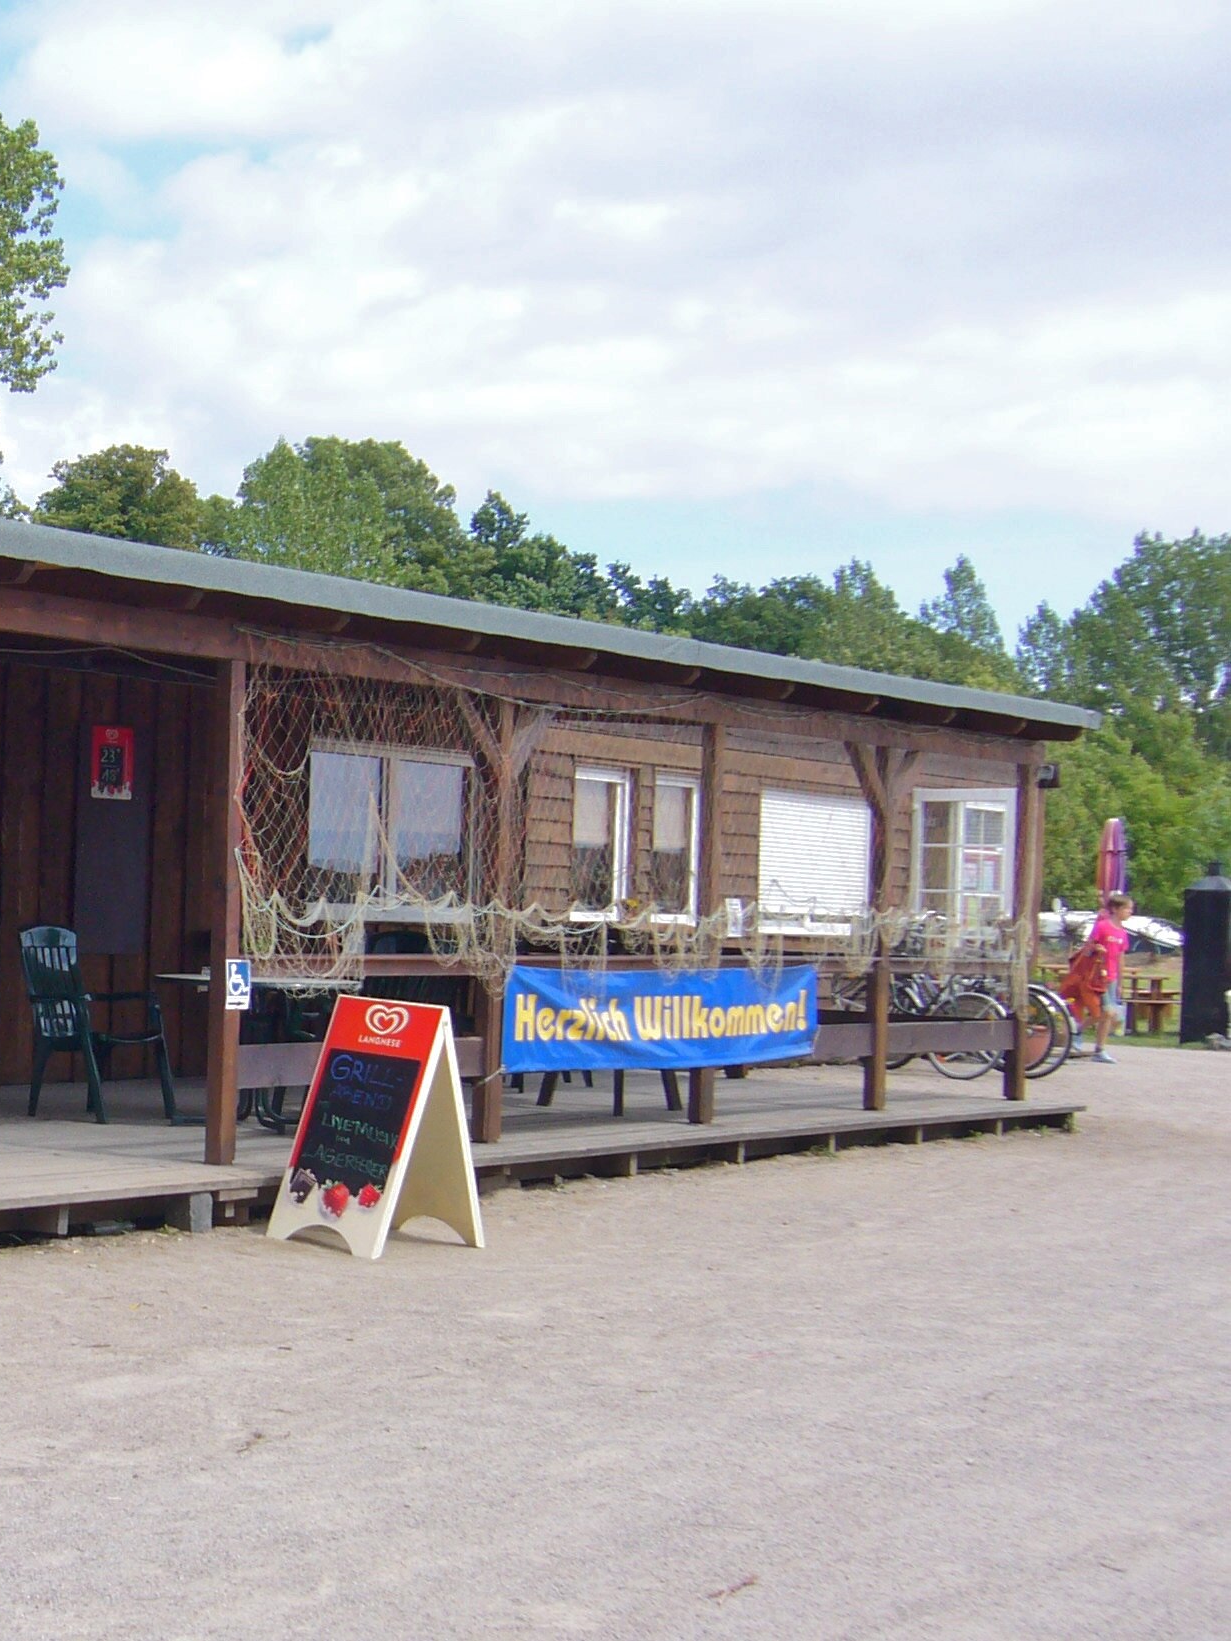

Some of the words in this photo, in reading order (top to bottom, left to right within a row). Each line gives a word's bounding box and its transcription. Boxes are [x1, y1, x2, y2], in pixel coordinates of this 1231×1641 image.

[514, 993, 632, 1041] Herzlich
[634, 989, 807, 1041] Willkommen!
[357, 1034, 401, 1048] LANGNESE
